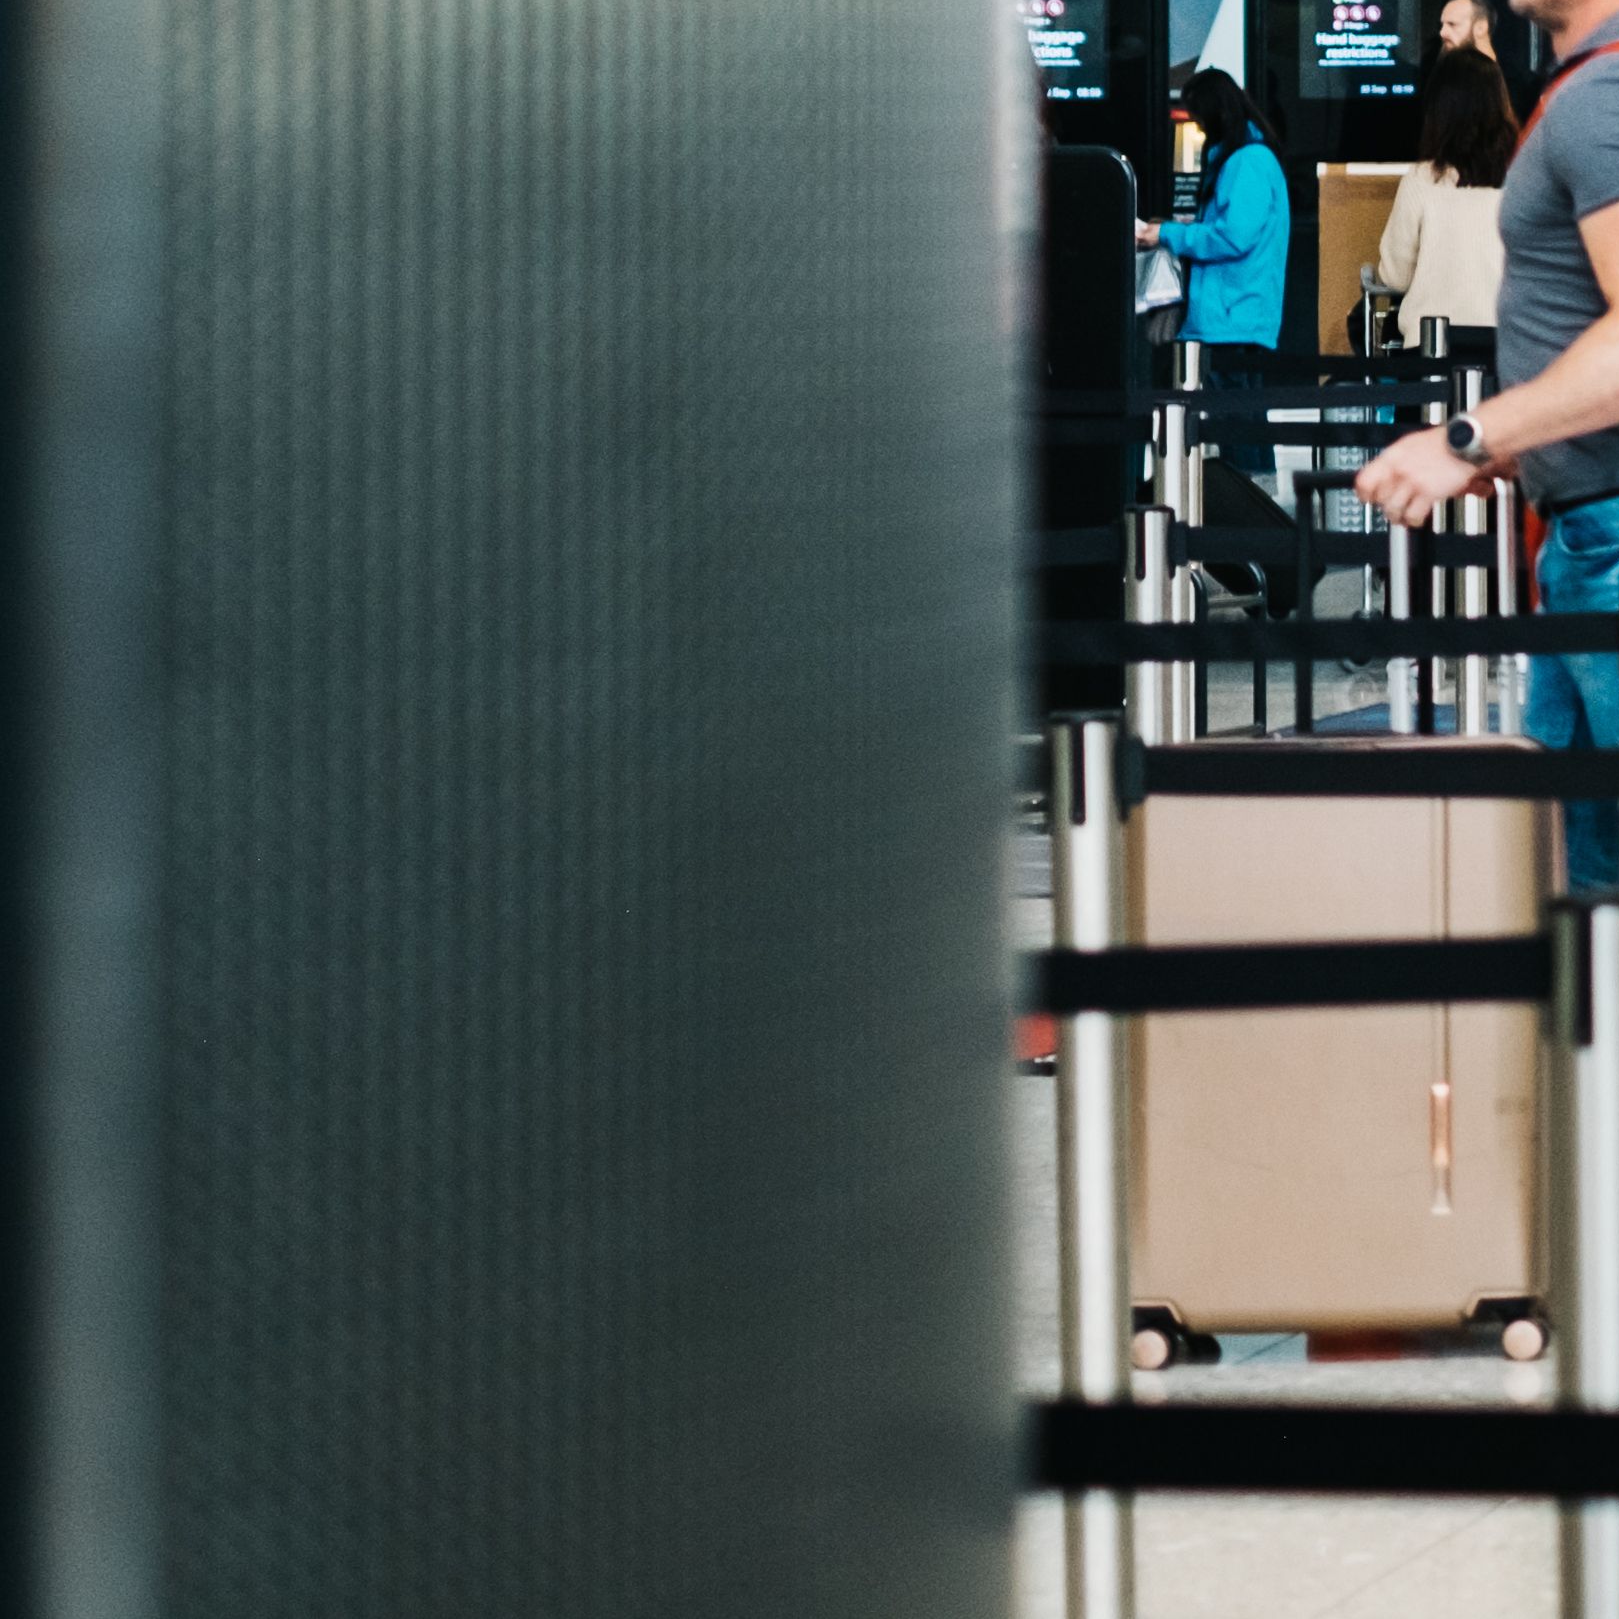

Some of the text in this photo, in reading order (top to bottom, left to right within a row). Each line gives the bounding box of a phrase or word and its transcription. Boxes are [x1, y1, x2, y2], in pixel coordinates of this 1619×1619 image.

[1315, 32, 1401, 48] Hand baggage
[1325, 46, 1389, 59] restrictions
